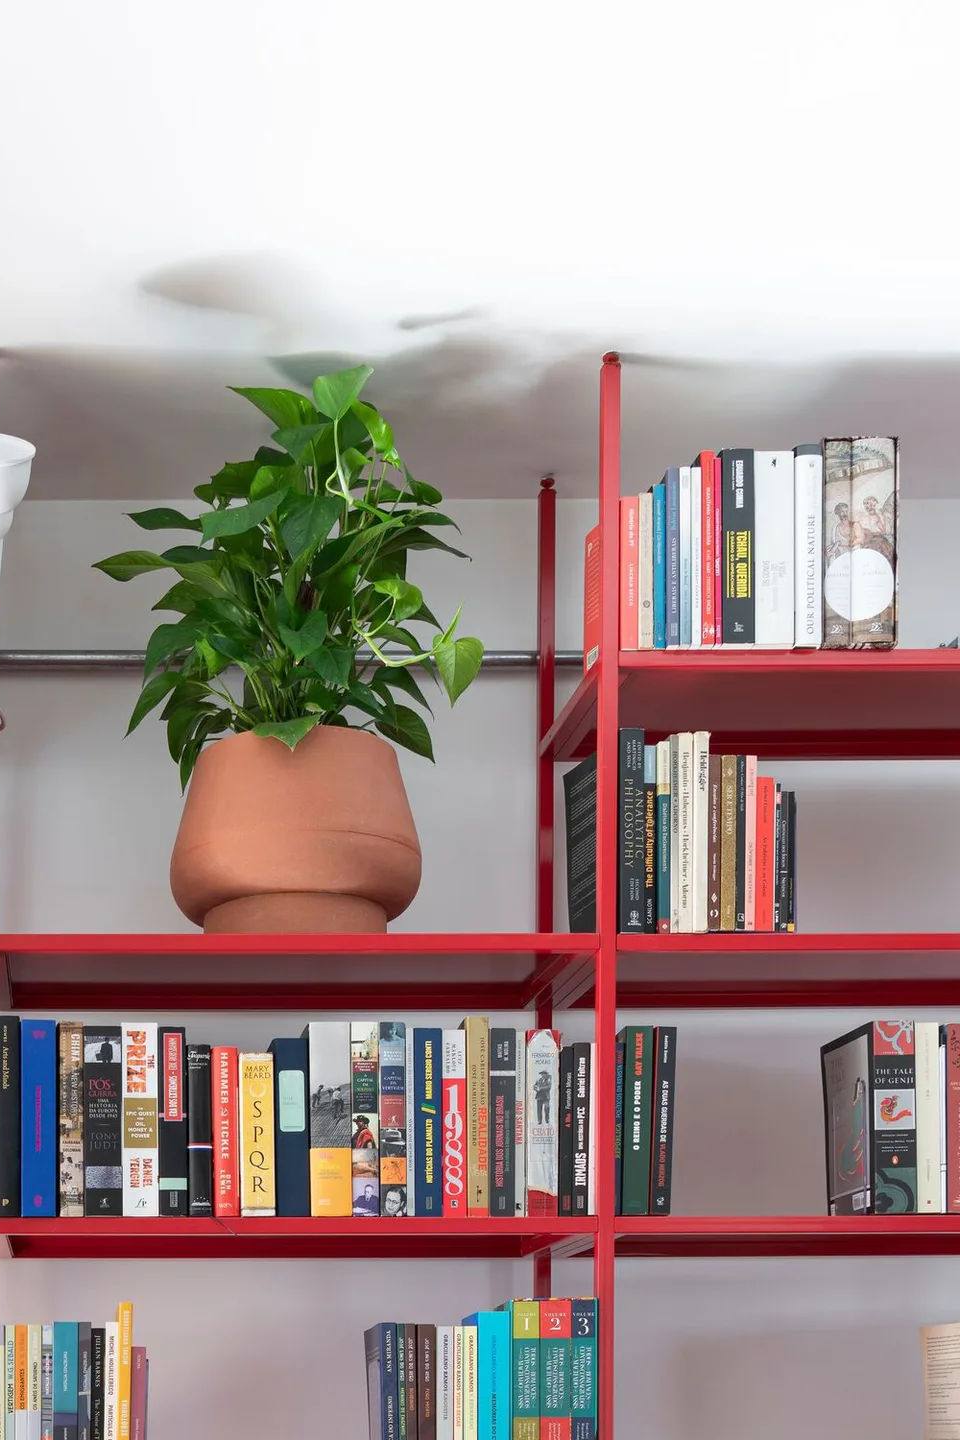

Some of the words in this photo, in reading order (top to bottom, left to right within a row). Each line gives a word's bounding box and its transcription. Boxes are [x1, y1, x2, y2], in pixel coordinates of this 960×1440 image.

[624, 779, 633, 868] PHILOSOPHY
[635, 789, 643, 859] ANALYTIC
[646, 830, 654, 839] of
[71, 1034, 81, 1062] CHINA
[127, 1031, 146, 1093] PRIZE
[220, 1052, 229, 1104] HAMMER
[70, 1090, 78, 1117] HISTORY
[90, 1132, 117, 1140] TONY
[90, 1141, 117, 1150] JUDT
[220, 1120, 229, 1160] TICKLE
[478, 1107, 487, 1171] REALIDADE
[524, 1318, 530, 1331] 1
[549, 1318, 561, 1330] 2
[578, 1318, 589, 1335] 3
